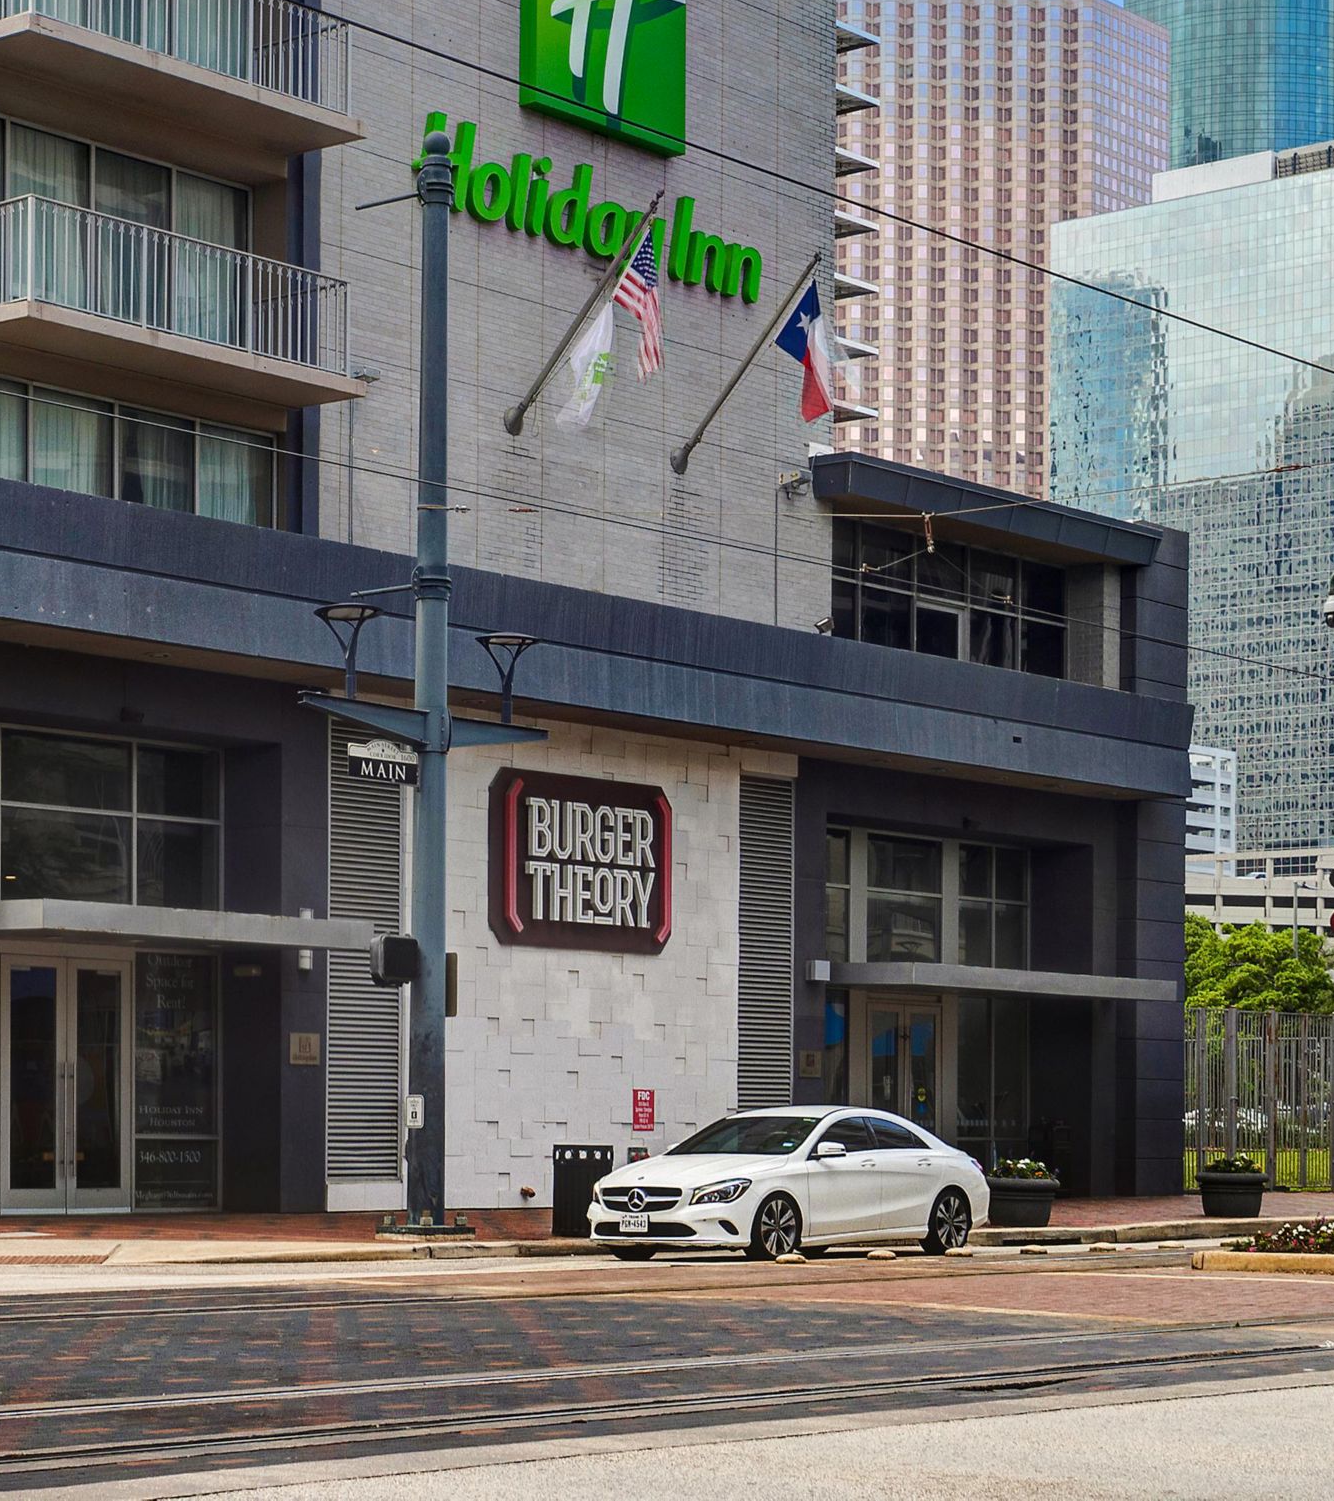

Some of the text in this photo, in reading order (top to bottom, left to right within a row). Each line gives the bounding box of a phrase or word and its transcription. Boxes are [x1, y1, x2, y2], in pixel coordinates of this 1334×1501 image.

[411, 111, 762, 304] Holiday Inn
[360, 760, 406, 781] MAIN
[526, 797, 656, 868] BURGER
[525, 861, 656, 929] THEORY
[637, 1091, 651, 1101] FDC
